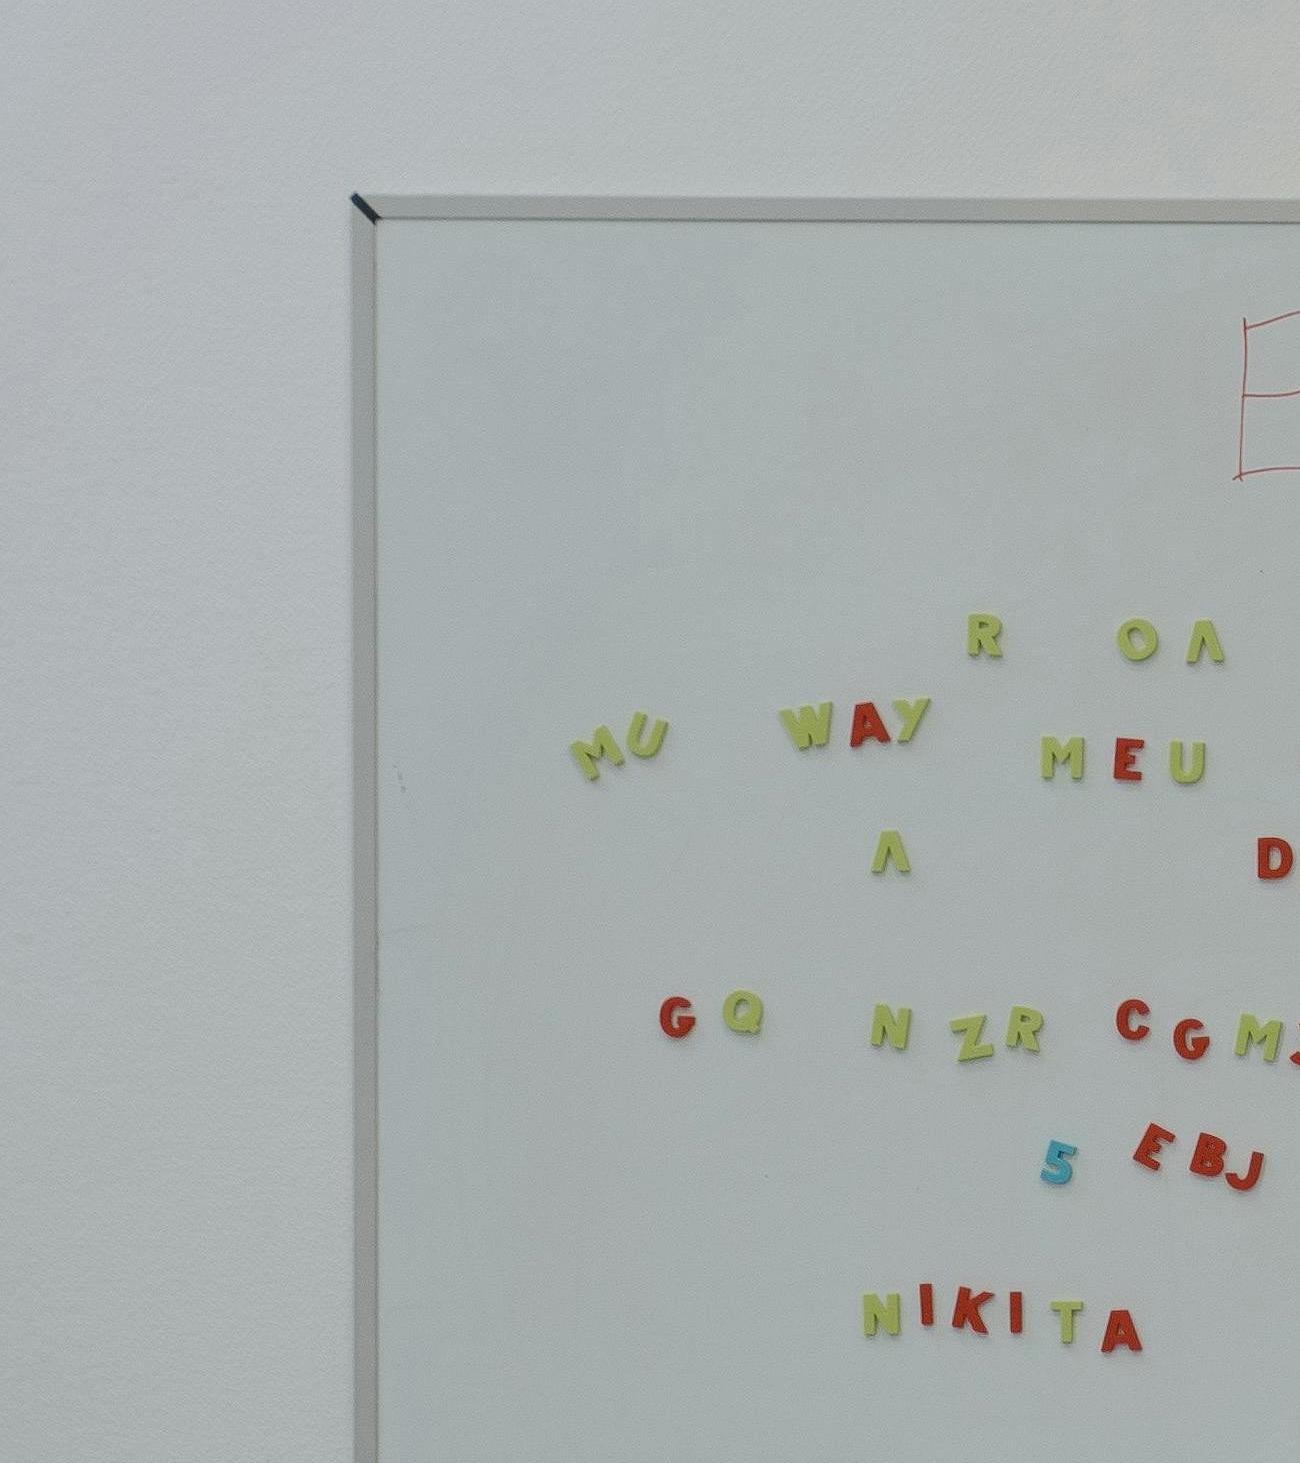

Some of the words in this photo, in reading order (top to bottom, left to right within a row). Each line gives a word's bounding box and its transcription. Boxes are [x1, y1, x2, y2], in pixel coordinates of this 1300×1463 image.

[779, 696, 932, 751] WAY
[1131, 1120, 1267, 1193] EBJ
[861, 1280, 1144, 1356] NIKITA
